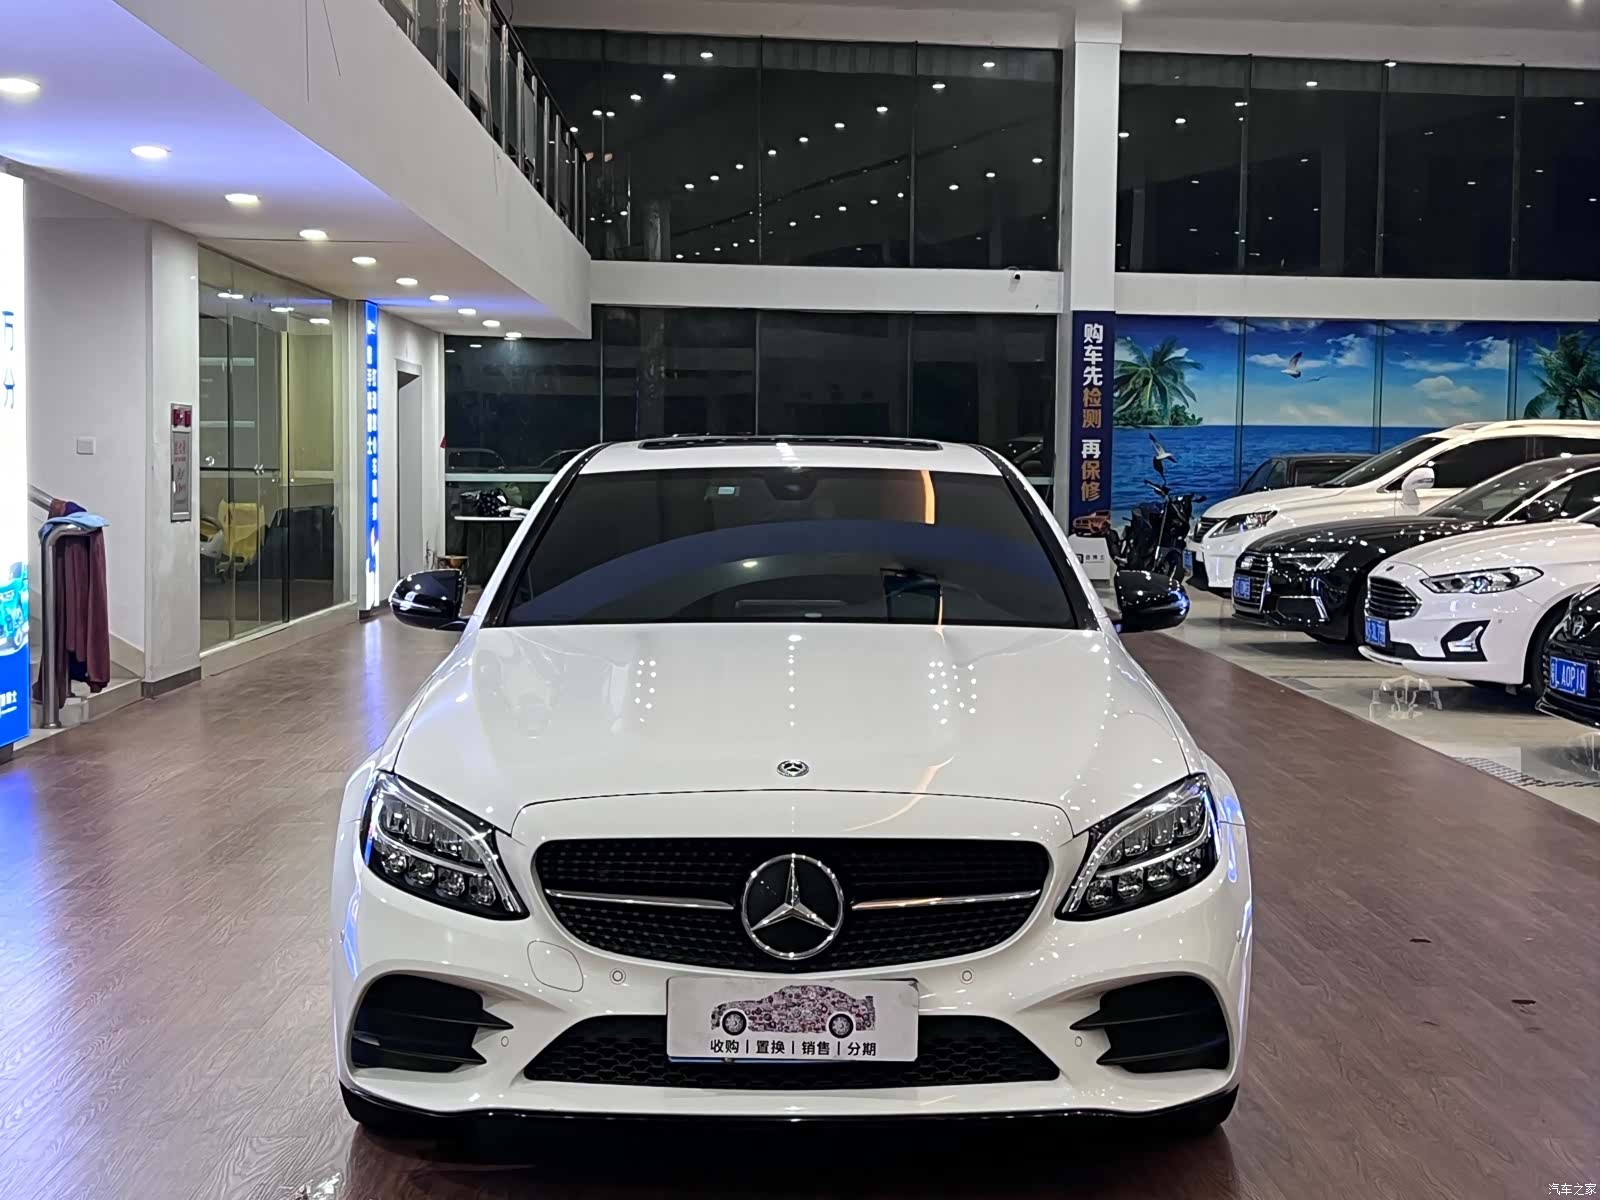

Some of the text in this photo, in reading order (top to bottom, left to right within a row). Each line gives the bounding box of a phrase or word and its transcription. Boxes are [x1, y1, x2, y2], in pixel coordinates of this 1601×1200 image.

[1081, 323, 1104, 501] 购车先检测 再保修
